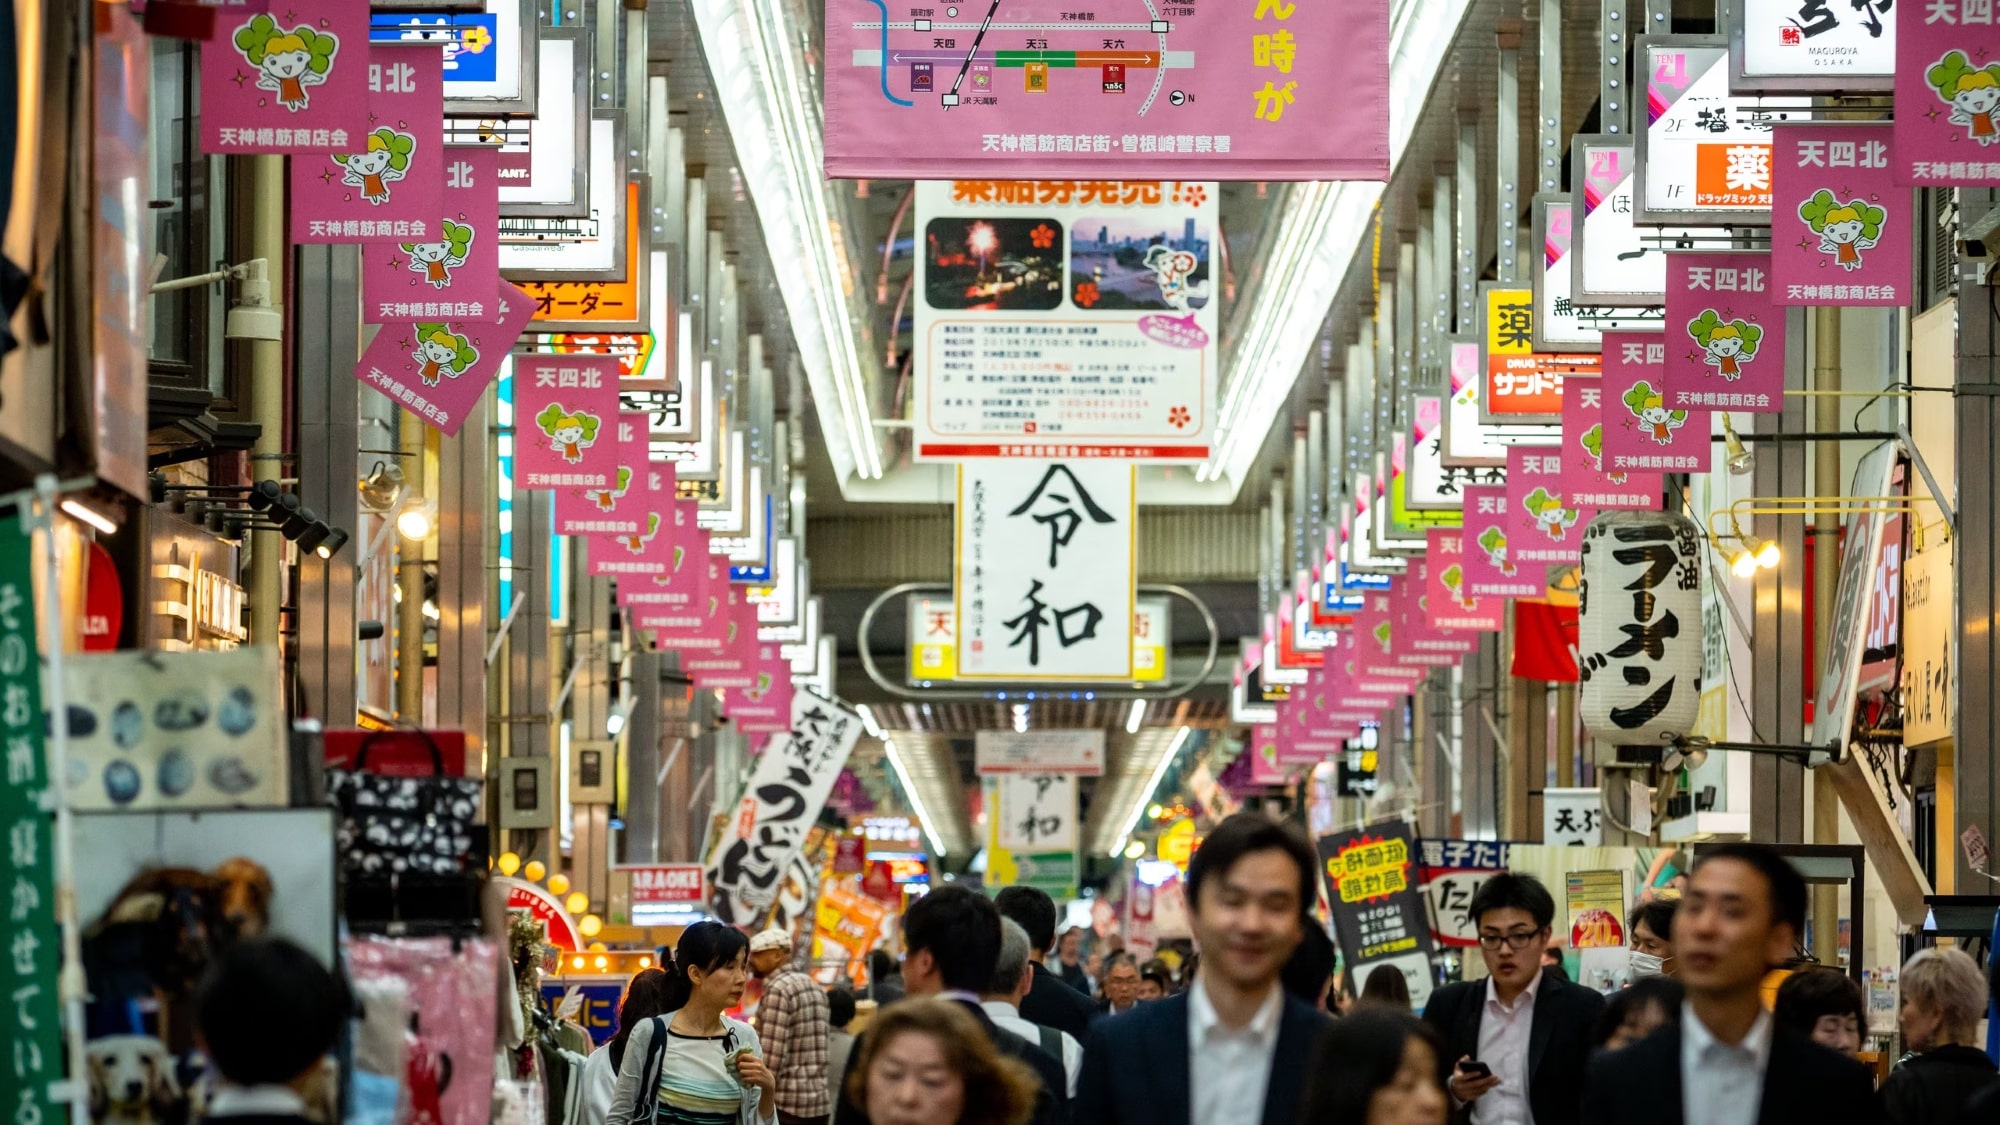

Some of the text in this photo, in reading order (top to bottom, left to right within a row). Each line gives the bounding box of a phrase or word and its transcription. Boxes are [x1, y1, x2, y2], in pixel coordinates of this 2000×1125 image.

[1059, 12, 1095, 21] 天神橋筋
[1162, 8, 1195, 16] 六丁目駅
[933, 38, 955, 49] 天四
[1026, 38, 1048, 49] 天五
[1102, 39, 1125, 49] 天六
[1808, 47, 1858, 56] MAGUROYA
[1654, 54, 1691, 90] TEN 4
[962, 97, 972, 105] JR
[1188, 94, 1195, 102] N
[1664, 118, 1688, 133] 2F
[219, 127, 348, 147] 天神橋筋商店会
[982, 134, 1231, 153] 天神橋筋商店街・曽根崎警察署
[1590, 151, 1608, 161] TEN
[1797, 140, 1888, 169] 天四北
[447, 161, 474, 188] 北
[1725, 146, 1770, 191] 薬
[1667, 184, 1686, 199] 1F
[1697, 194, 1757, 204] ドラッグミック
[309, 220, 426, 237] 天神橋筋商店会
[1687, 266, 1765, 292] 天四北
[1787, 285, 1896, 300] 天神橋筋商店会
[379, 302, 484, 317] 天神橋筋商店会
[535, 292, 623, 315] オーダー
[1507, 358, 1536, 369] DRUG
[536, 367, 602, 389] 天四北
[367, 366, 449, 426] 天神橋筋商店会
[1676, 391, 1770, 408] 天神橋筋商店会
[1614, 455, 1699, 468] 天神橋筋商店会
[527, 473, 607, 486] 天神橋筋商店会
[1572, 493, 1651, 506] 天神橋筋商店会
[564, 520, 638, 533] 天神橋筋商店会
[1516, 549, 1581, 562] 天神橋筋商店
[597, 562, 666, 573] 天神橋筋商店会
[1002, 463, 1118, 667] 令和
[1471, 583, 1537, 595] 天神橋筋商店会
[1606, 524, 1680, 730] ラーメン
